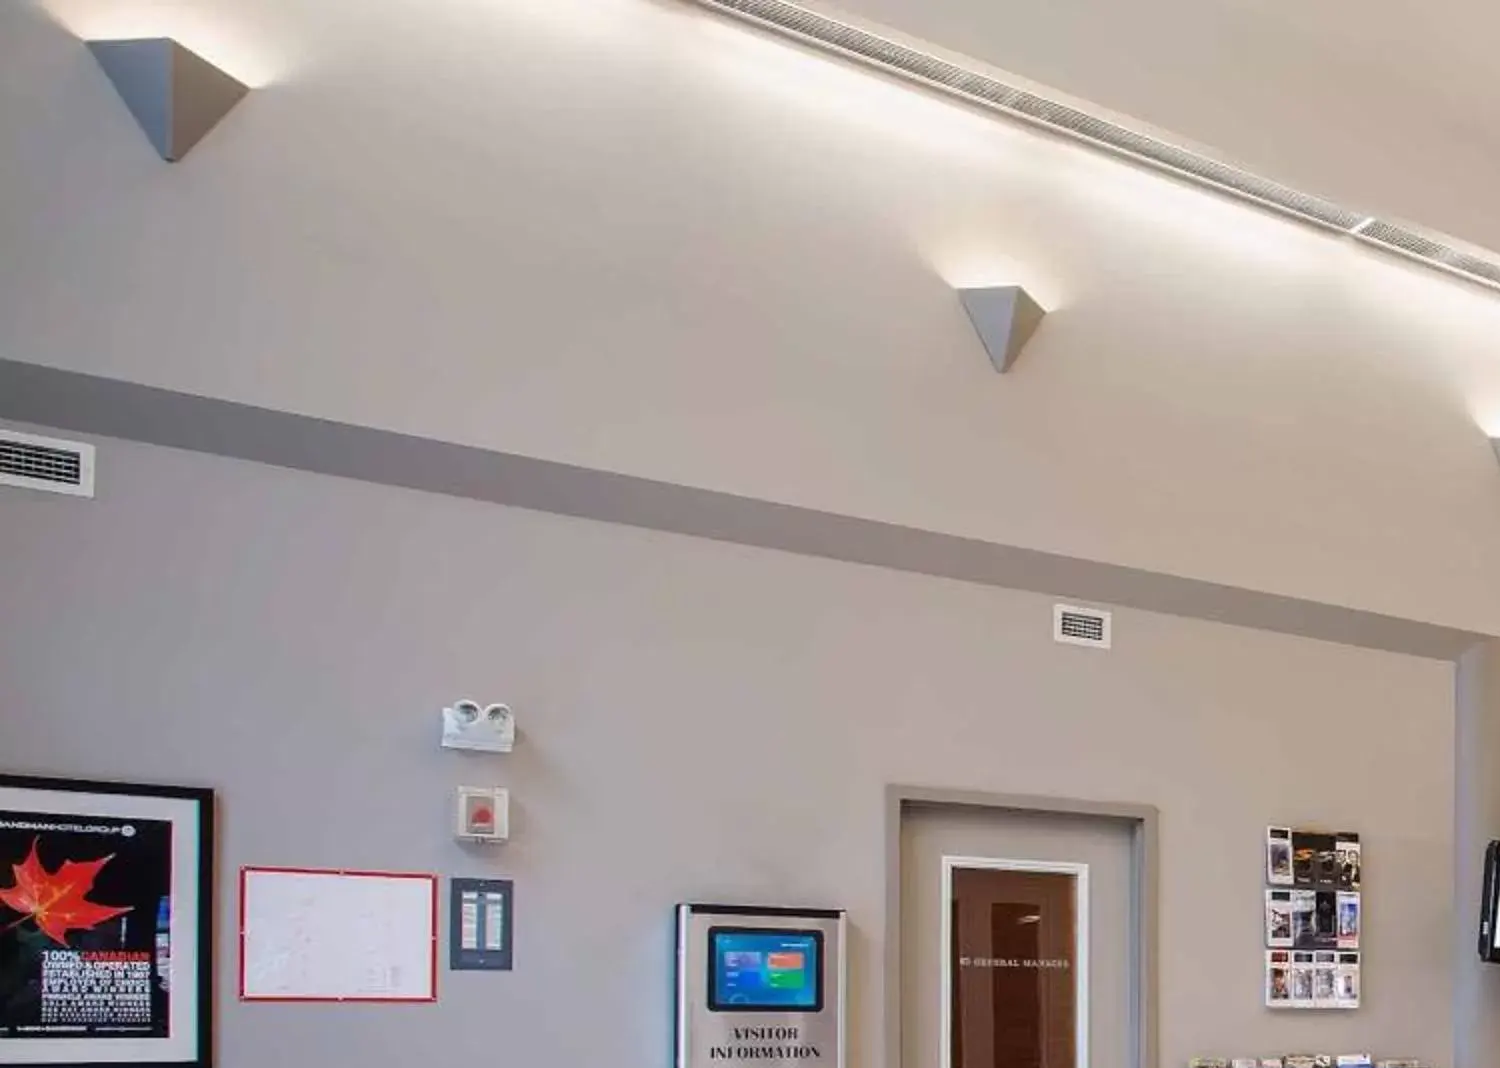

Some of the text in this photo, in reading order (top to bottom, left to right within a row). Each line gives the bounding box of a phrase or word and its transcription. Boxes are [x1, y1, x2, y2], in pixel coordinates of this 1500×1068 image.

[42, 951, 150, 962] 100% CANADIAN
[94, 961, 150, 971] OPERATED
[731, 1027, 798, 1041] VISITOR
[710, 1045, 820, 1059] INFORMATION
